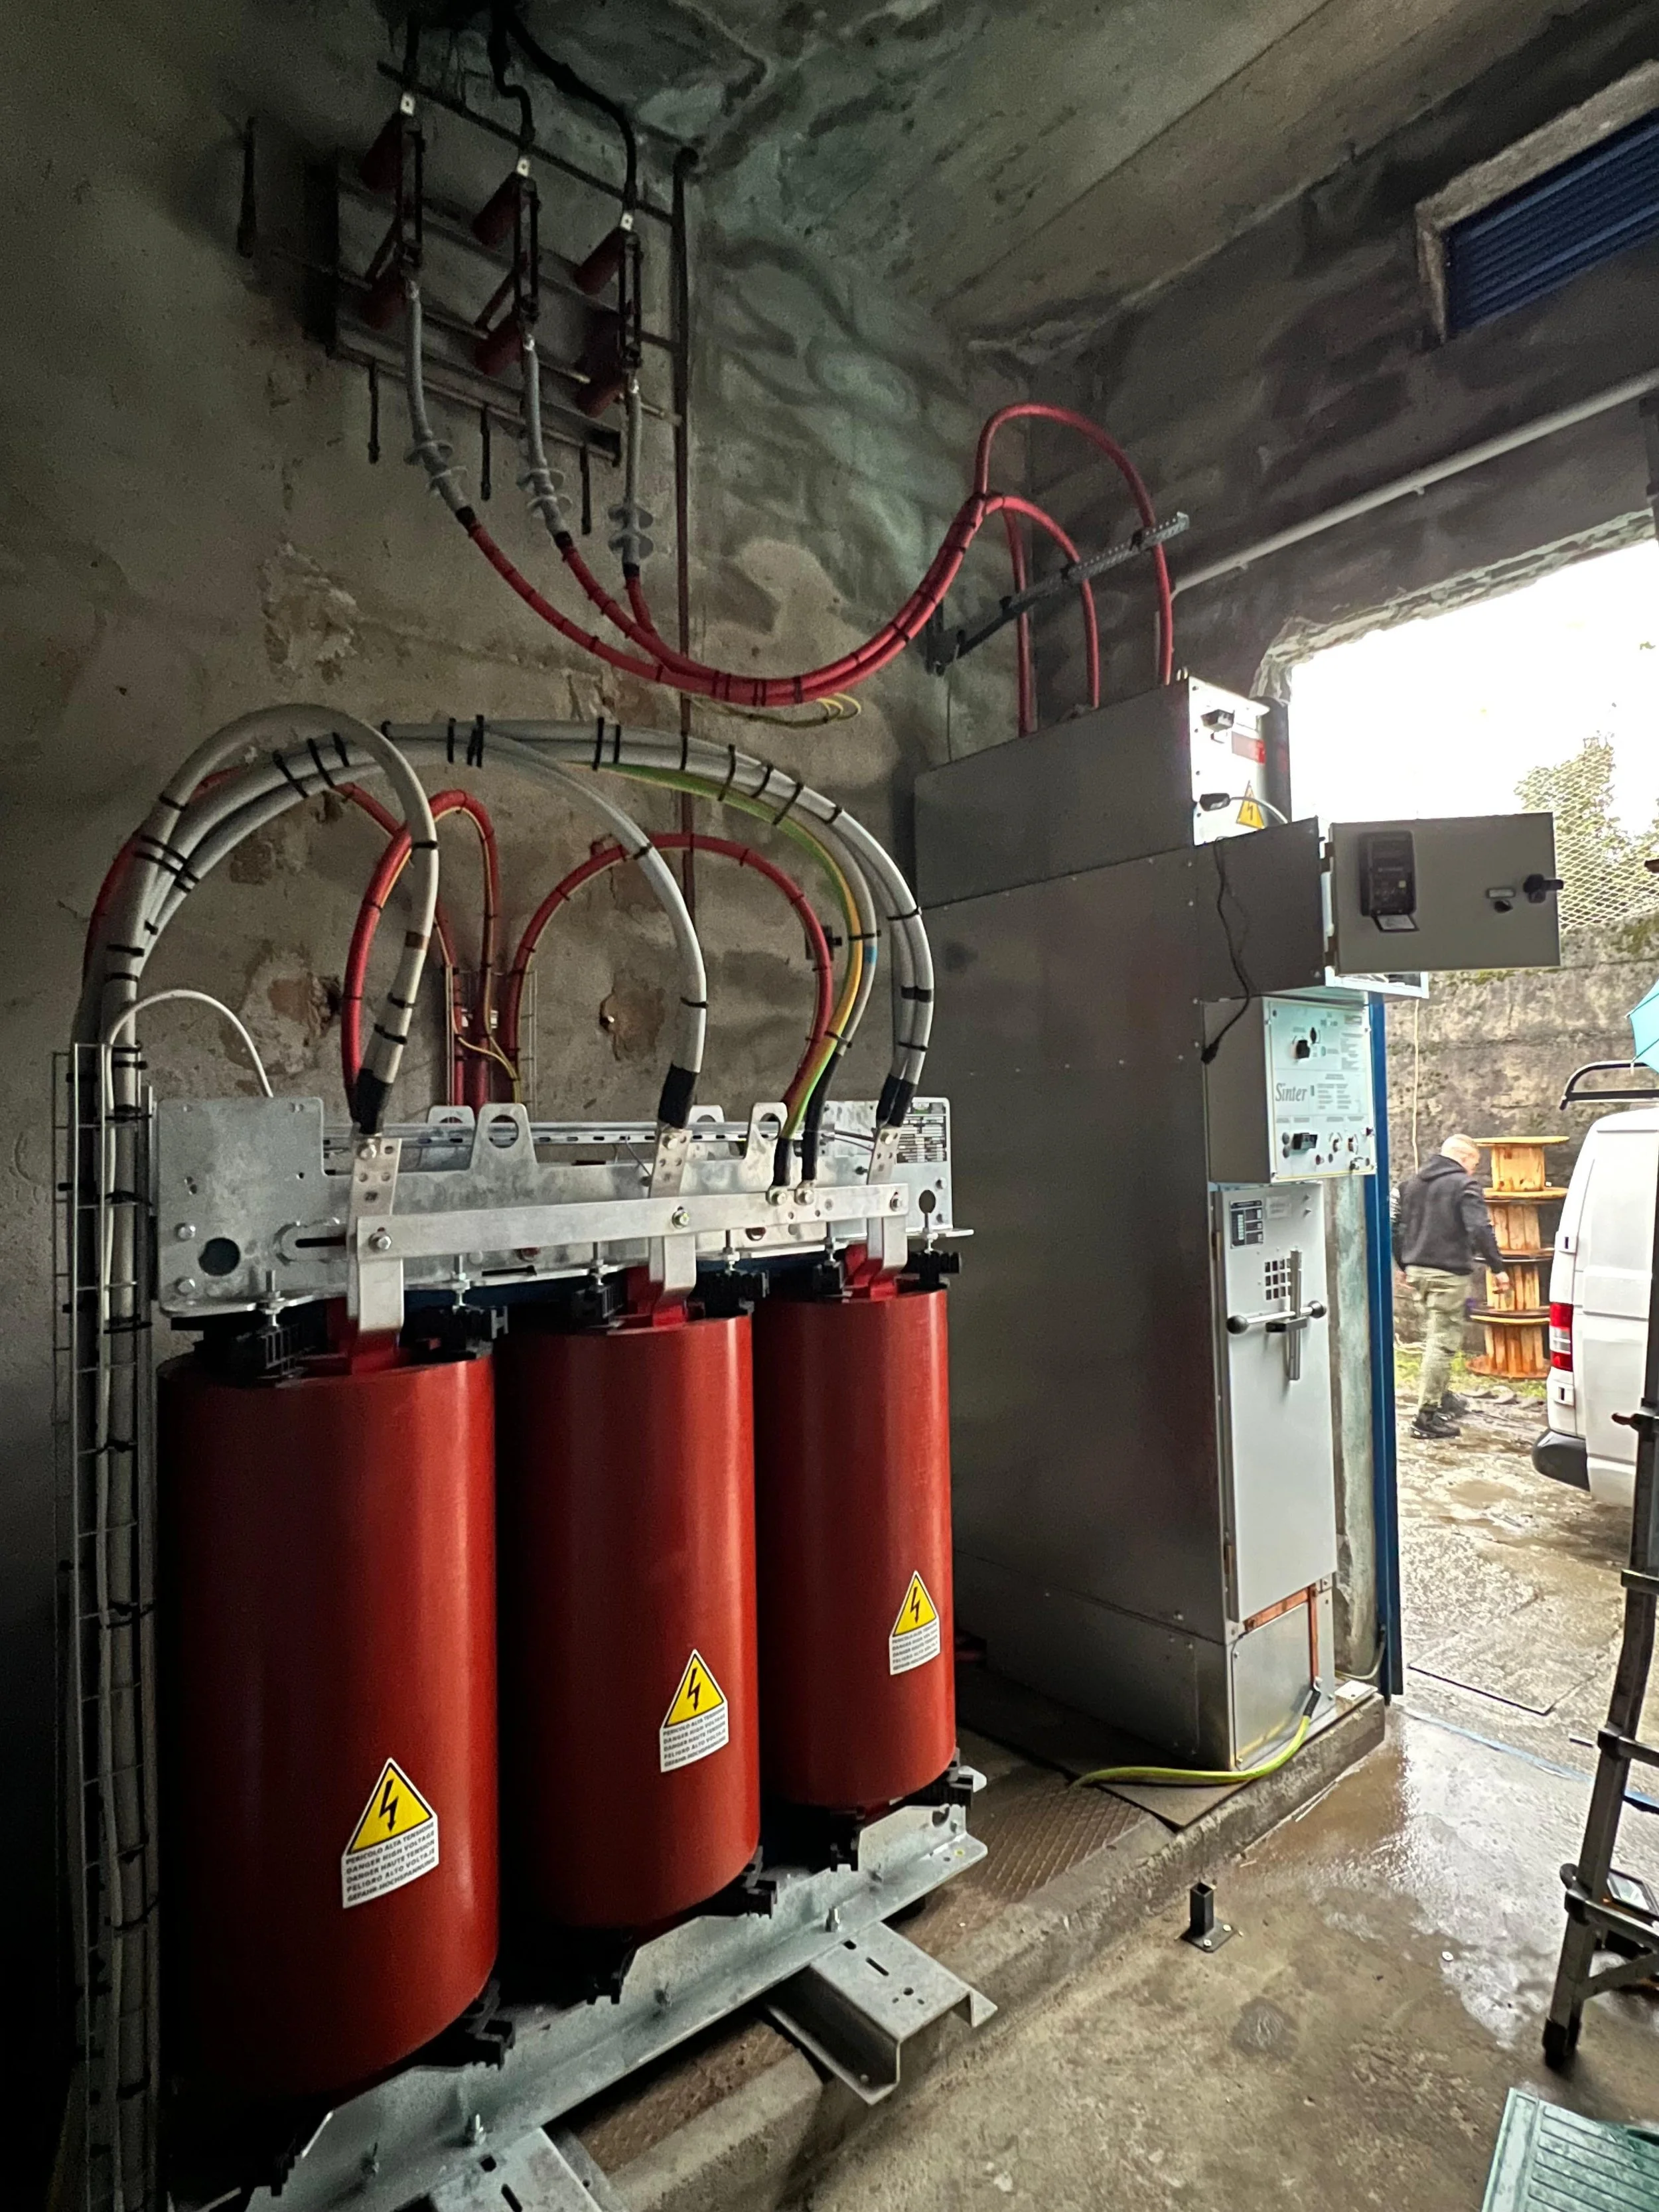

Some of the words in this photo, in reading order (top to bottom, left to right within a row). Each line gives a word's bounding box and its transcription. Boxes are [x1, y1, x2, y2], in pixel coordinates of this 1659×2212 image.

[1275, 1082, 1307, 1102] Sinter
[664, 1732, 687, 1744] DANGER
[664, 1740, 687, 1751] DANGER
[664, 1747, 689, 1759] PELIGRO
[346, 1848, 383, 1864] PERICOLO
[385, 1840, 401, 1850] ALTA
[403, 1822, 433, 1842] TENSIONE
[346, 1858, 380, 1874] DANGER
[383, 1848, 402, 1860] HIGH
[404, 1830, 434, 1850] VOLTAGE
[346, 1868, 379, 1883] DANGER
[381, 1856, 404, 1870] HAUTE
[407, 1839, 434, 1858] TENSION
[347, 1876, 382, 1893] PELIGRO
[386, 1866, 403, 1878] ALTO
[406, 1848, 434, 1868] VOLTAJE
